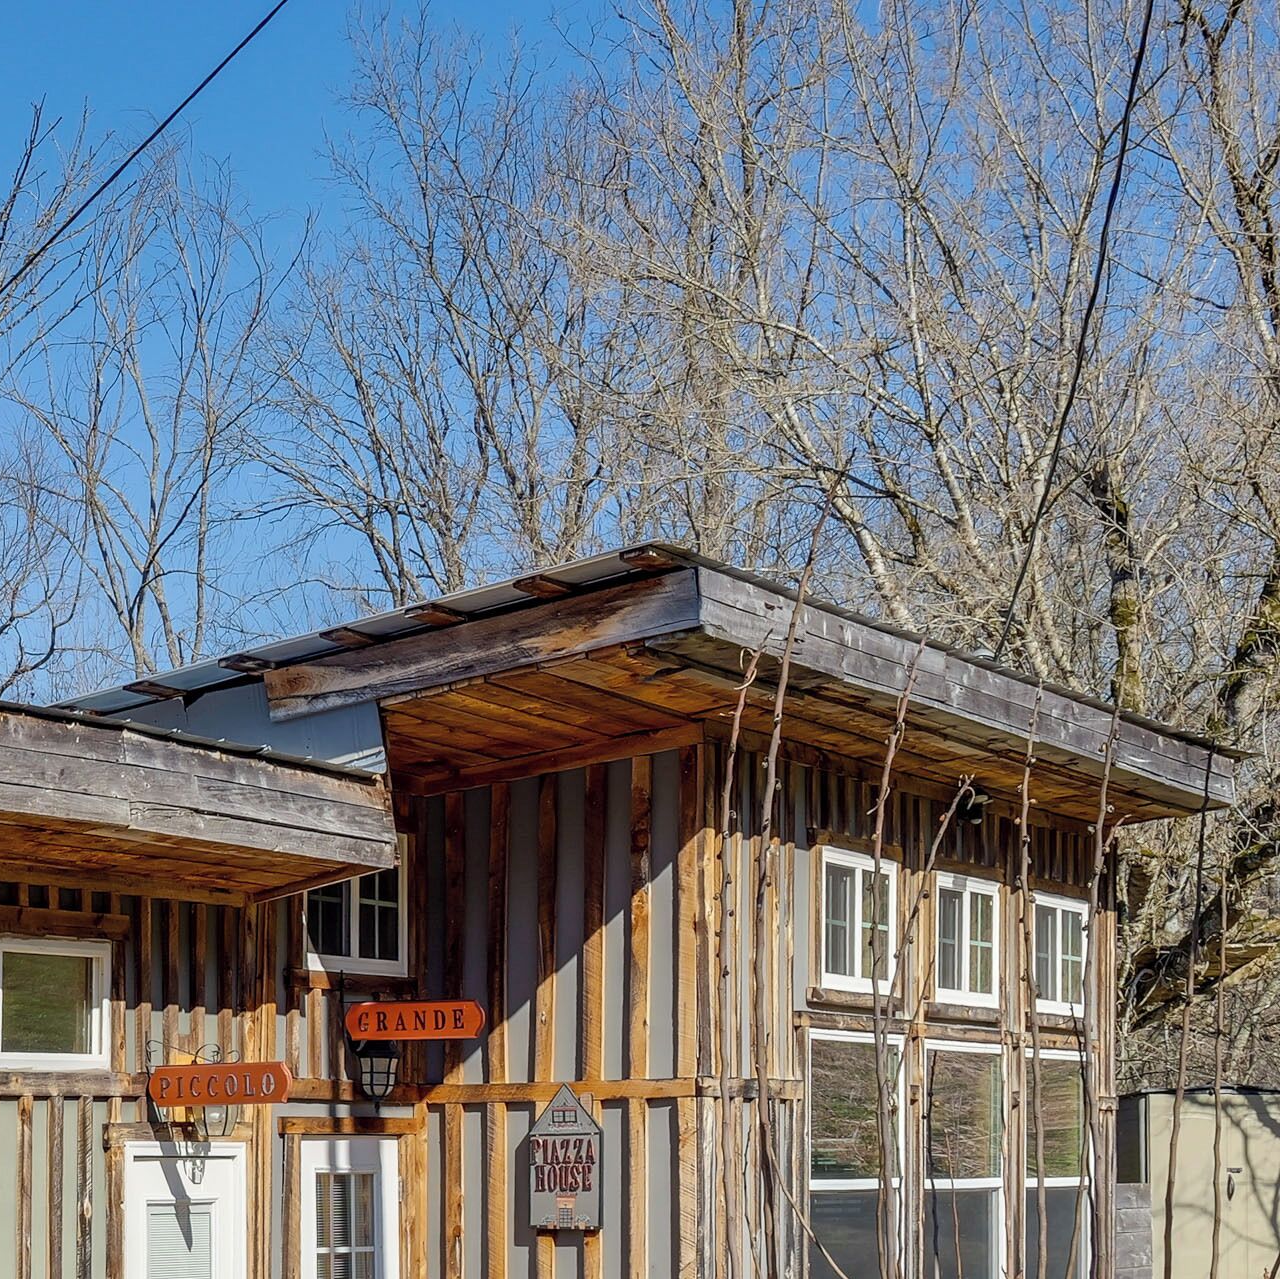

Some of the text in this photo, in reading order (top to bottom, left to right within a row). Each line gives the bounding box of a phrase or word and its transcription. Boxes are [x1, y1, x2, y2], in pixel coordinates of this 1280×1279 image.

[357, 1008, 465, 1033] GRANDE
[159, 1072, 276, 1099] PICCOLO
[530, 1137, 596, 1165] PIAZZA
[534, 1164, 593, 1193] HOUSE
